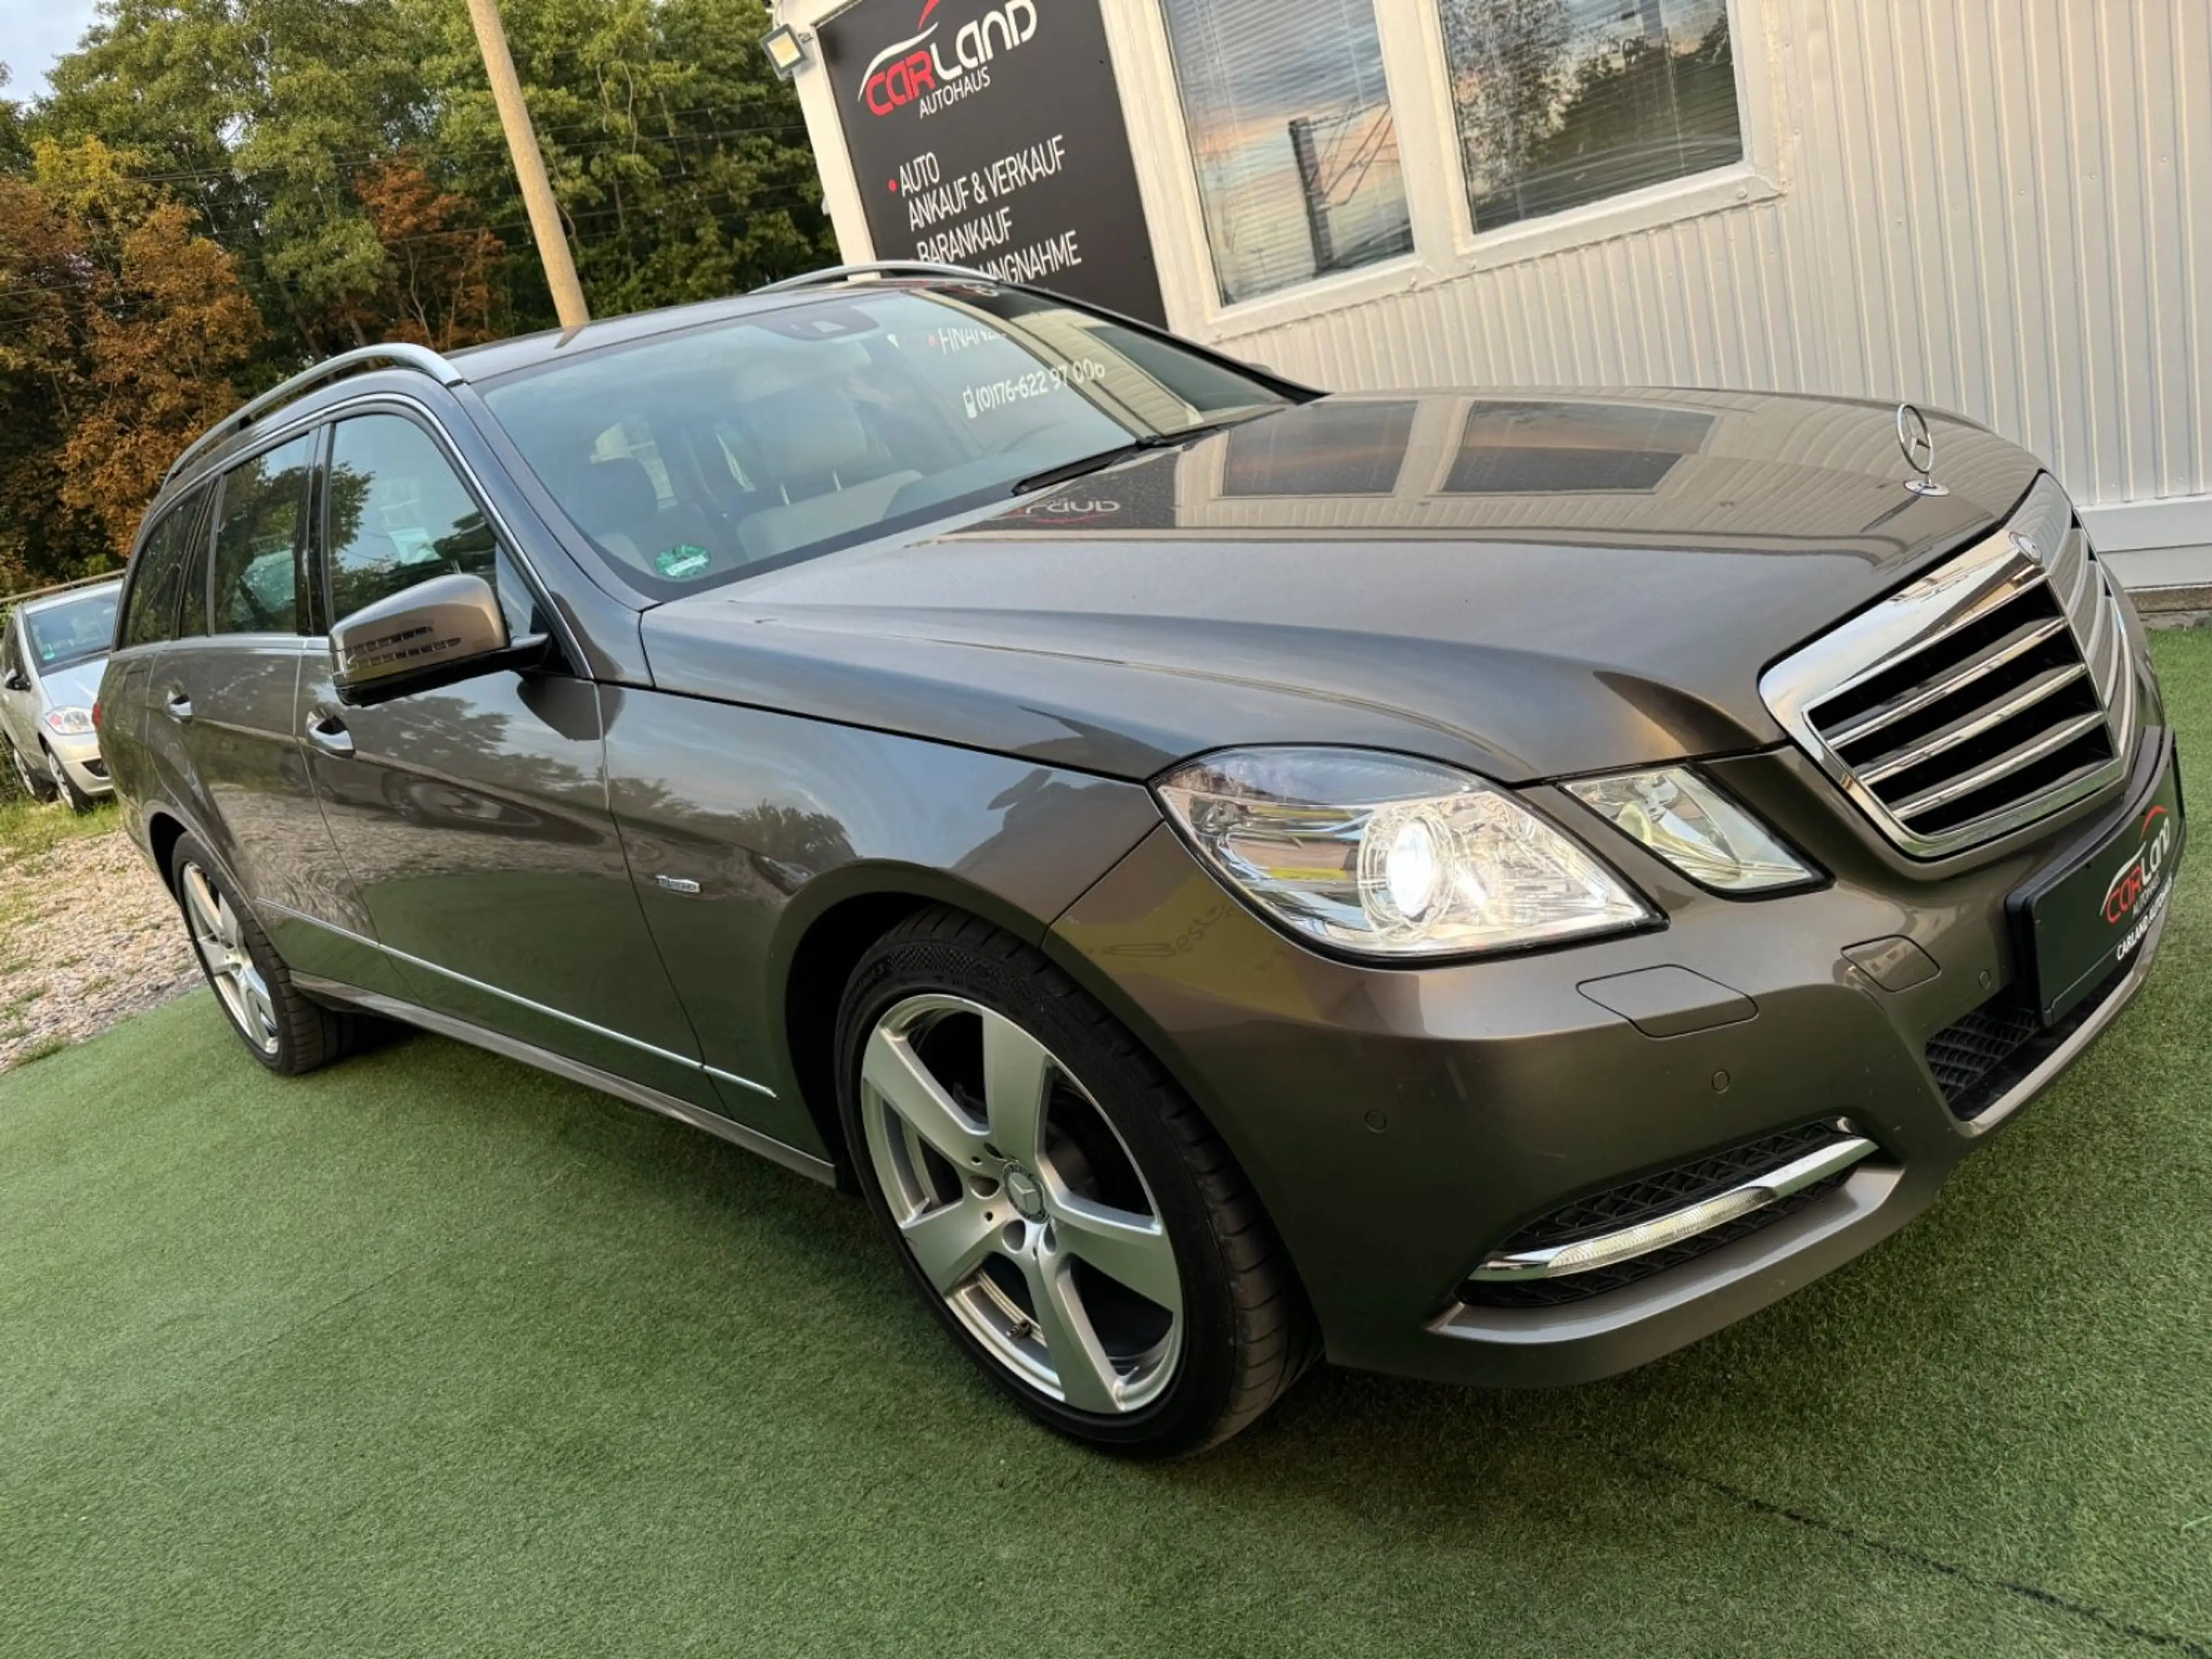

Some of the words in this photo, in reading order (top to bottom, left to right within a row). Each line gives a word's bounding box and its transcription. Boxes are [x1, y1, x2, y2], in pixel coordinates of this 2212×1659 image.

[919, 66, 991, 119] AUTOHAUS
[900, 151, 940, 198] AUTO
[908, 176, 969, 232] ANKAUF
[971, 171, 989, 204] &
[984, 134, 1065, 198] VERKAUF
[916, 206, 1013, 263] BARANKAUF
